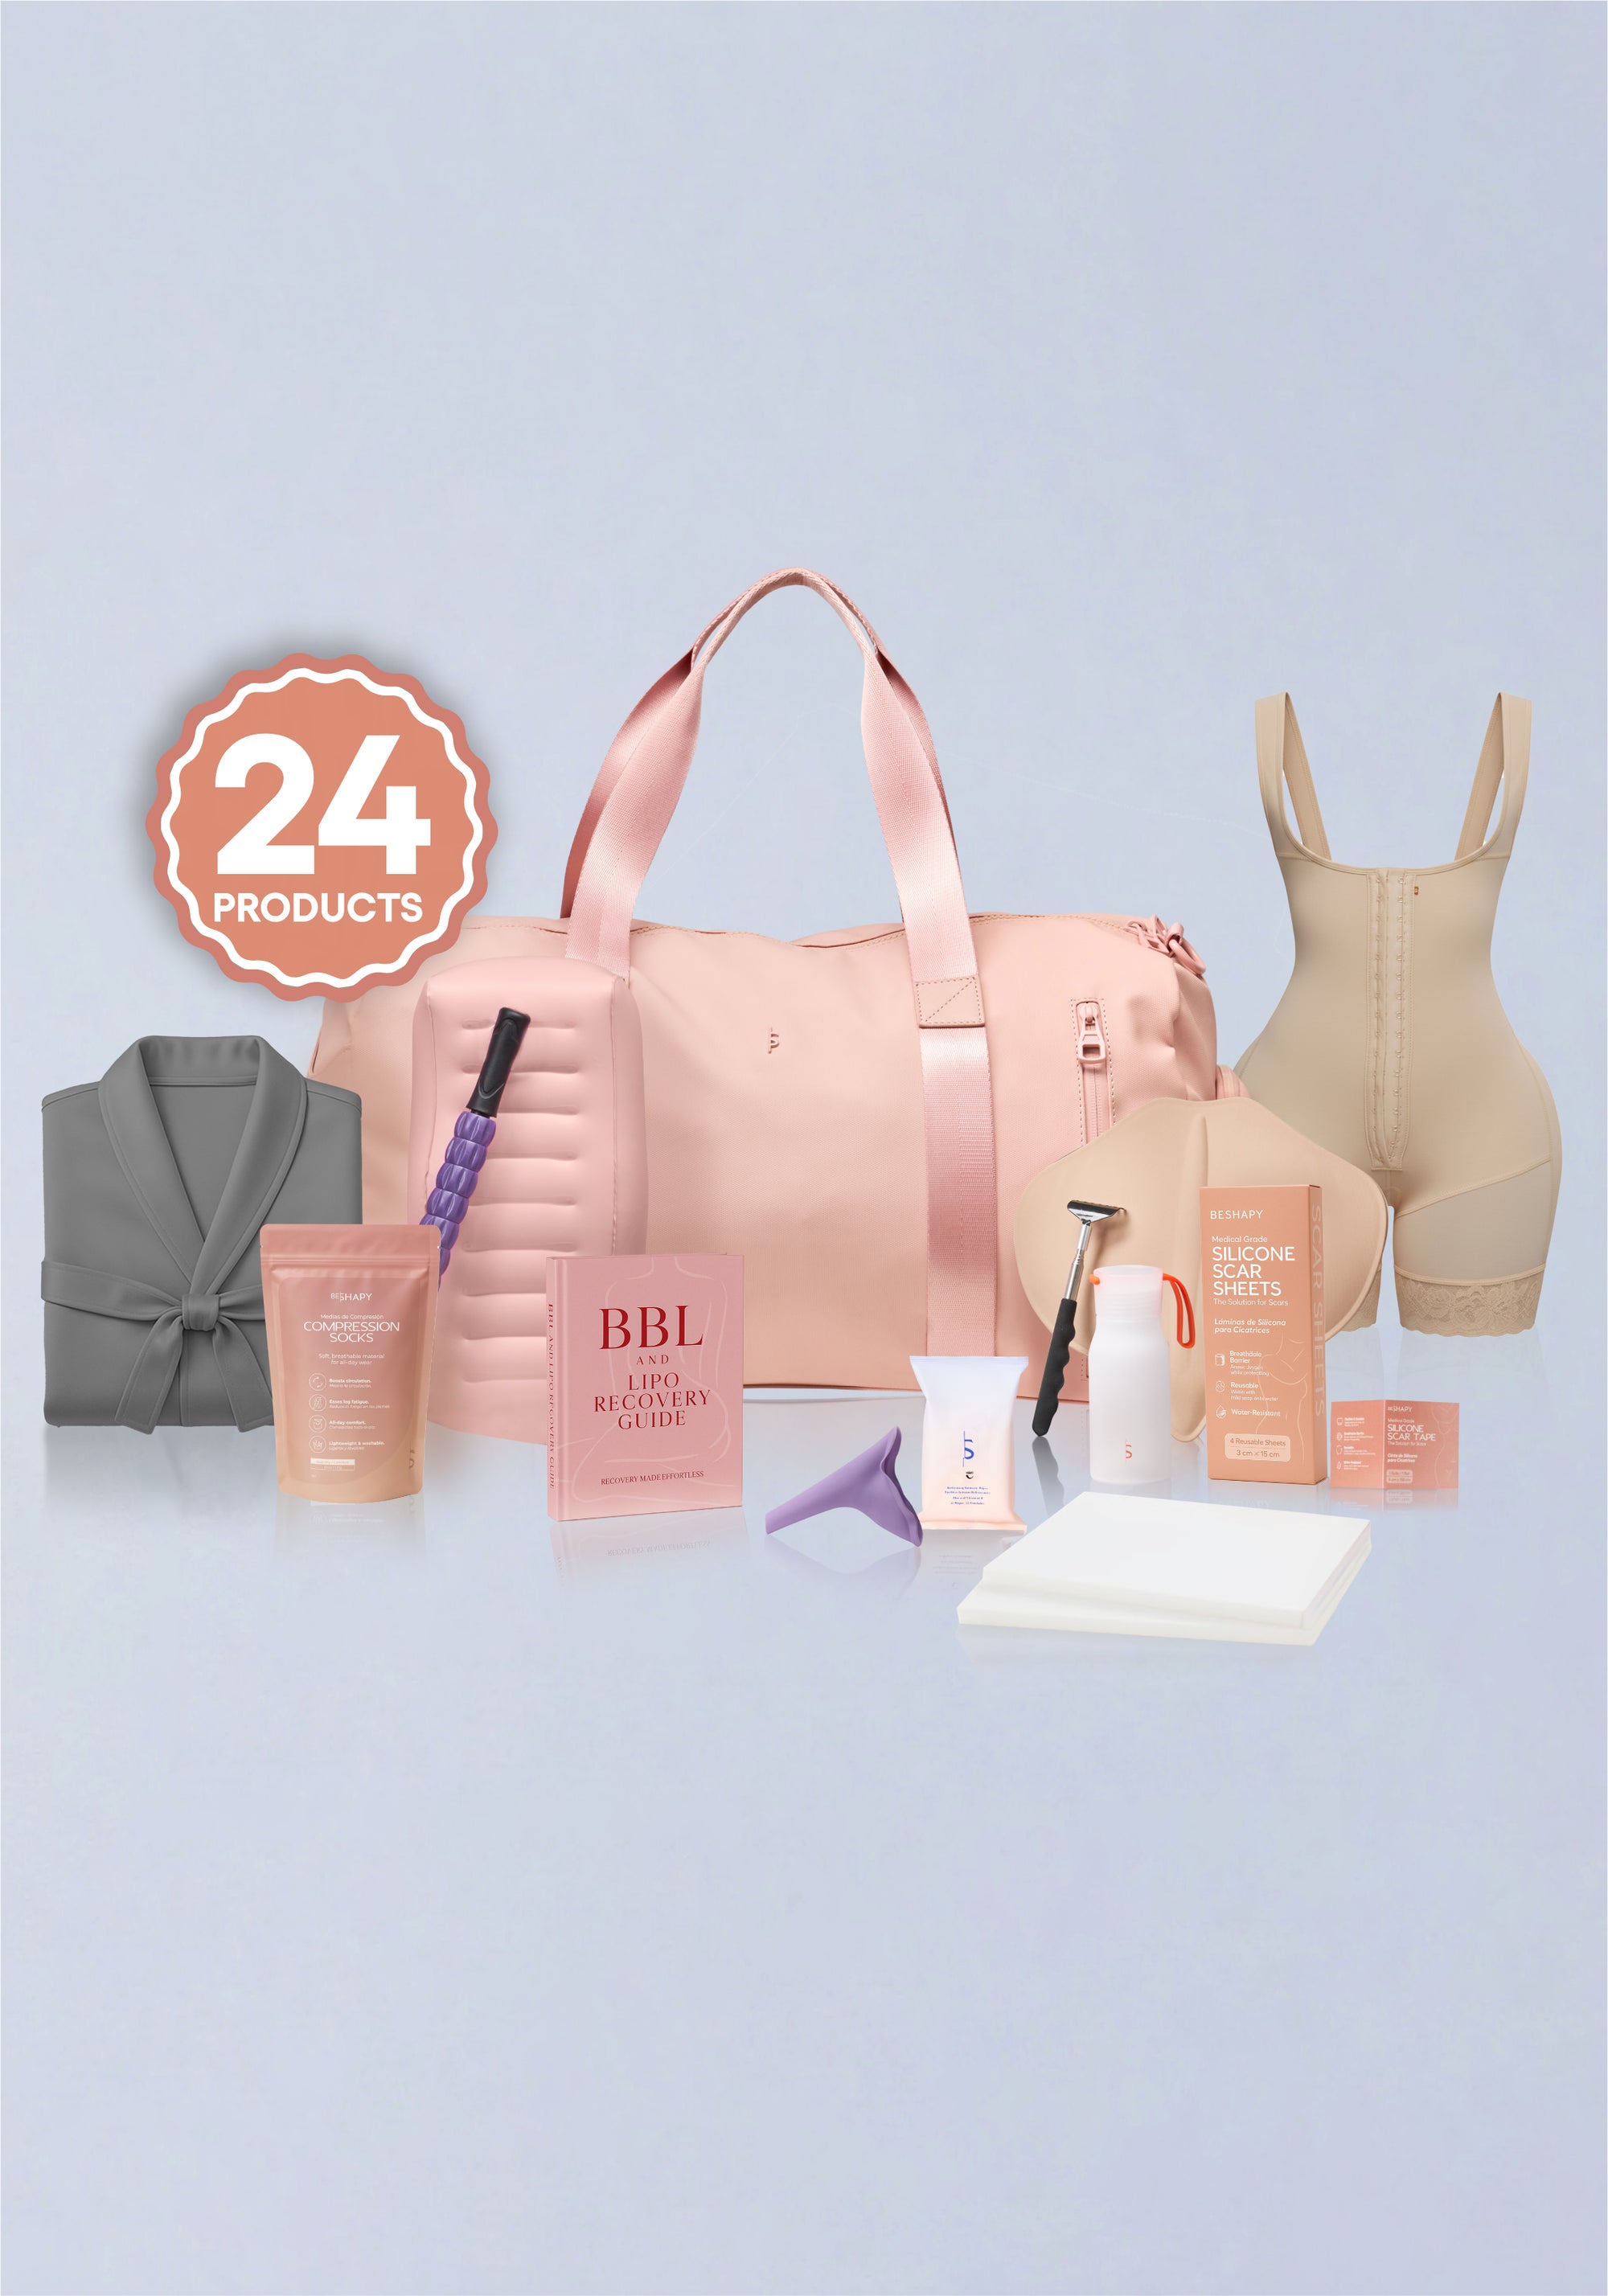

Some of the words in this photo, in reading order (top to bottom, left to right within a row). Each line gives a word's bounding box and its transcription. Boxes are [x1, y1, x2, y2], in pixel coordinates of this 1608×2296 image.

[1210, 1210, 1263, 1219] BESHAPY
[1312, 1205, 1323, 1289] SCAR
[1212, 1246, 1295, 1261] SILICONE
[1212, 1264, 1261, 1278] SCAR
[1213, 1281, 1282, 1296] SHEETS
[330, 1292, 372, 1302] BESHAPY
[303, 1321, 400, 1331] COMPRESSION
[598, 1305, 704, 1350] BBL
[1214, 1318, 1245, 1326] Láminas
[1257, 1318, 1286, 1326] Silicona
[1214, 1326, 1232, 1335] para
[1233, 1326, 1270, 1334] Cicatrices
[330, 1332, 374, 1343] SOCKS
[636, 1354, 669, 1366] AND
[1314, 1302, 1325, 1417] SHEETS
[628, 1371, 679, 1391] LIPO
[1230, 1381, 1259, 1389] Reusable
[593, 1389, 711, 1412] RECOVERY
[1231, 1408, 1281, 1417] Water-Resistant
[617, 1410, 687, 1430] GUIDE
[1387, 1424, 1424, 1433] SILICONE
[1236, 1437, 1263, 1445] Reusable
[1387, 1433, 1410, 1441] SCAR
[1413, 1433, 1436, 1441] TAPE
[601, 1475, 638, 1485] RECOVERY
[639, 1474, 662, 1482] MADE
[662, 1470, 704, 1480] EFFORTLESS
